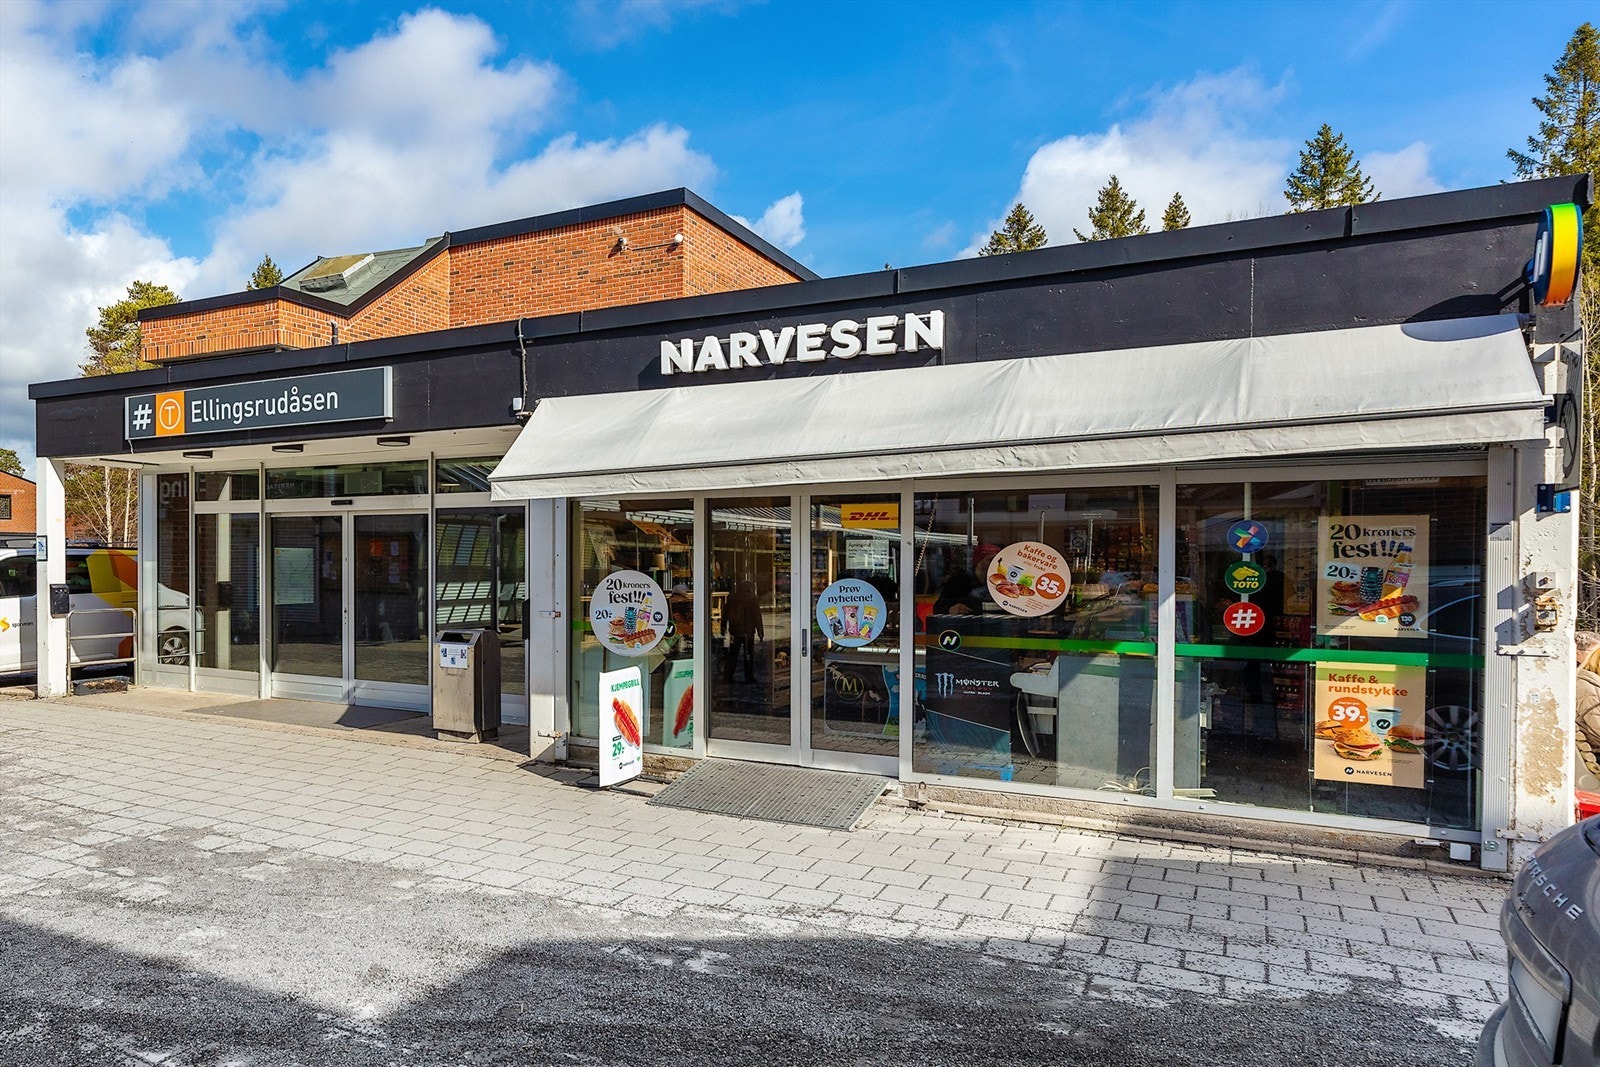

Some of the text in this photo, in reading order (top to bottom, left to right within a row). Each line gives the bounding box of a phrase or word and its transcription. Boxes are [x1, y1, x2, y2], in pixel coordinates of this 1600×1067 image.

[660, 310, 945, 376] NARVESEN
[191, 386, 339, 425] Ellingsrudåsen
[849, 511, 891, 521] DHL
[1330, 523, 1417, 541] 20 kroners
[1016, 549, 1058, 570] bakervare
[1023, 544, 1058, 563] Kaffe og
[606, 578, 651, 591] 20 kroners
[839, 585, 861, 594] Prøv
[1233, 581, 1259, 589] TOTO
[827, 593, 873, 605] nyhetene!
[955, 678, 1000, 688] MONSTER
[1328, 673, 1379, 684] Kaffe &
[610, 678, 640, 693] KJEMPEGRILL
[1328, 684, 1408, 697] rundstykke
[1356, 769, 1393, 777] NARVESEN
